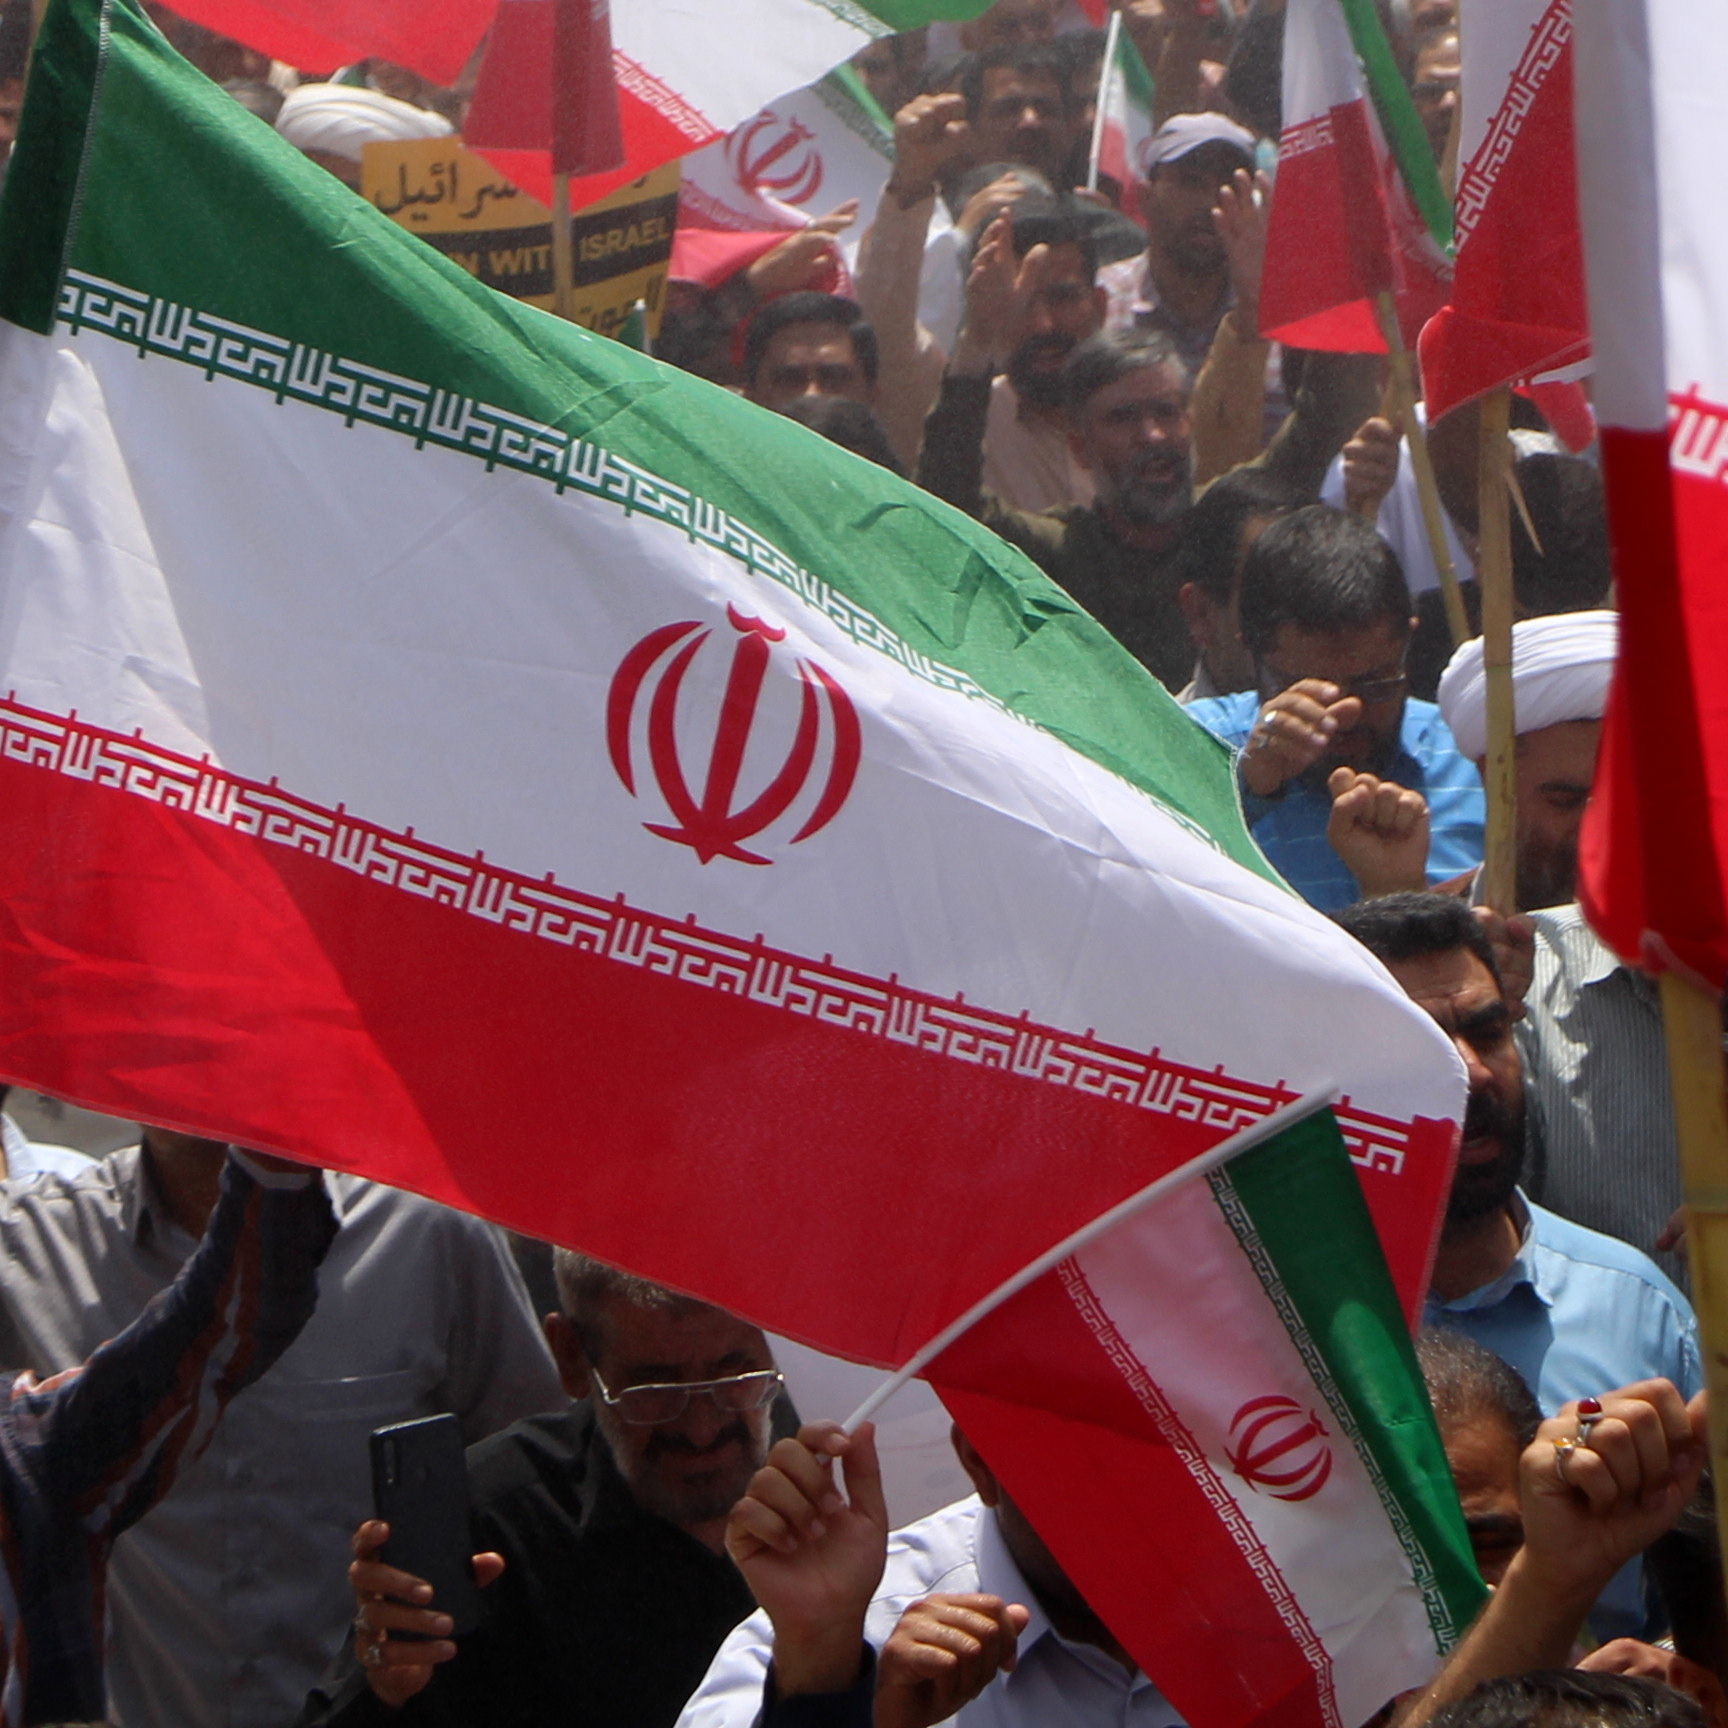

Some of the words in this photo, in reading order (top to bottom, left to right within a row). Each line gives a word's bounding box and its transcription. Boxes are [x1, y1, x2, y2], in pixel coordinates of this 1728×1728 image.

[374, 162, 519, 221] سرائیل
[488, 244, 553, 275] WIT
[579, 216, 669, 262] ISRAEL
